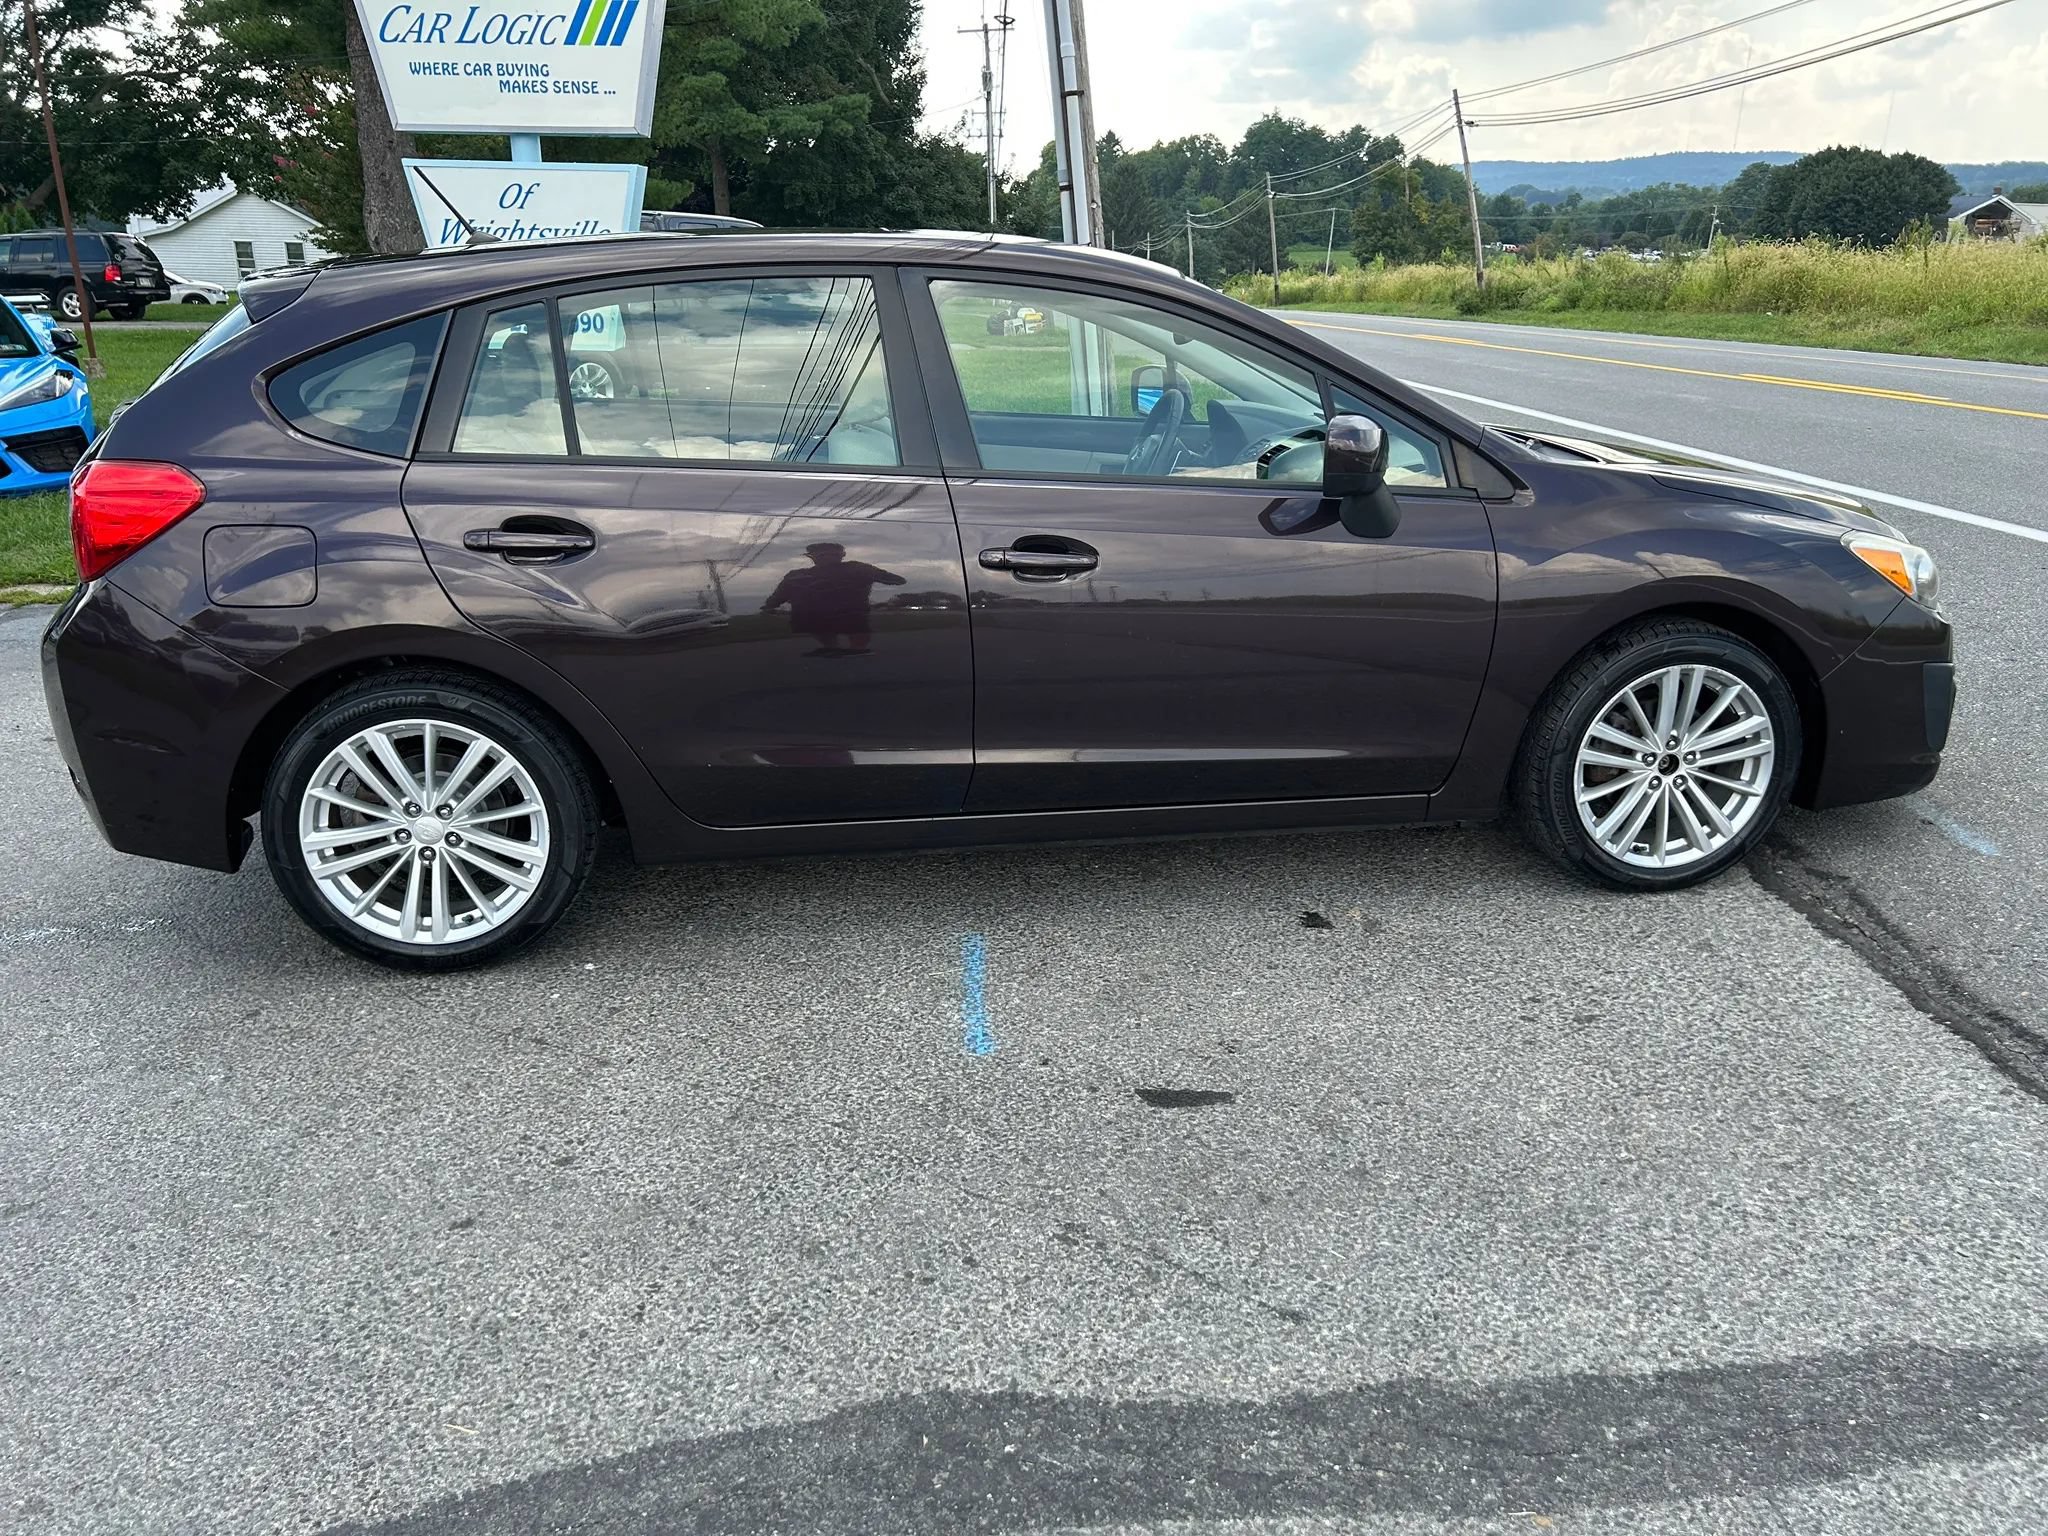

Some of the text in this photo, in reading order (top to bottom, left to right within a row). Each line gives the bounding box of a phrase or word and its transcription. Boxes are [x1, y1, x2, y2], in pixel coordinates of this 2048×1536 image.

[379, 5, 566, 45] CAR LOGIC
[409, 62, 549, 77] WHERE CAR BUYING
[499, 80, 548, 93] MAKES
[553, 81, 599, 94] SENSE
[499, 183, 541, 209] Of
[574, 312, 605, 333] 90
